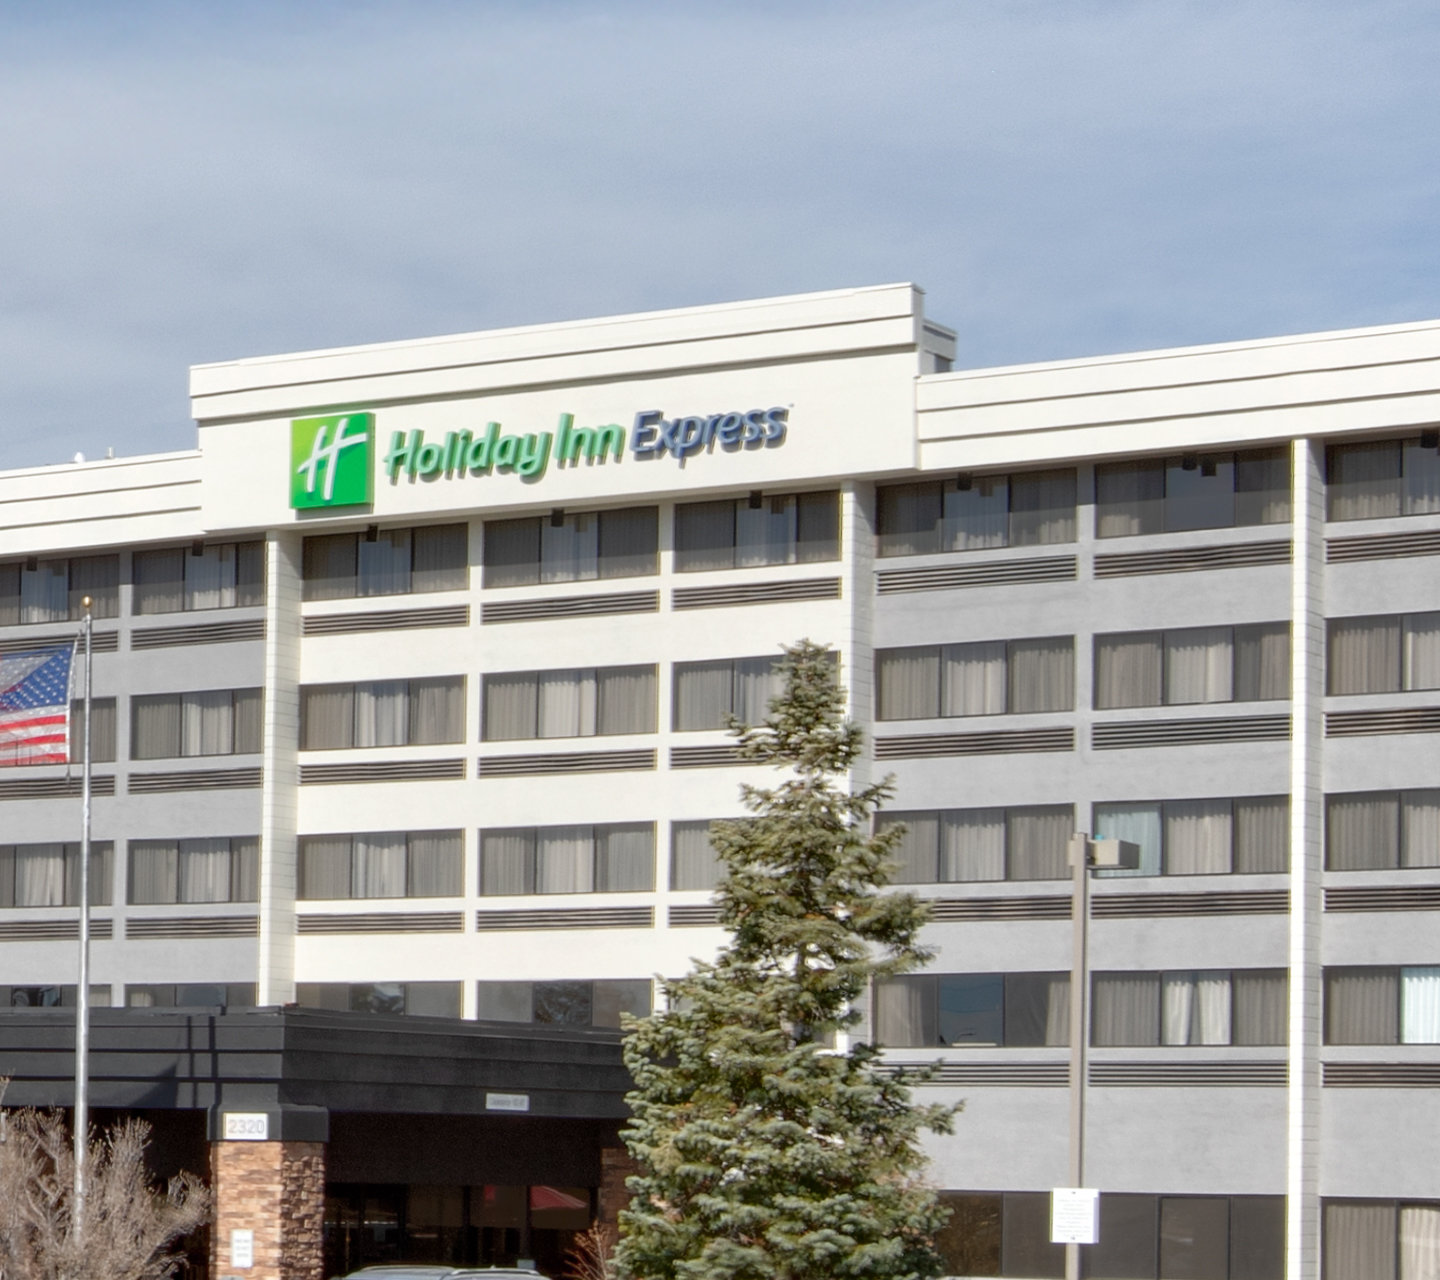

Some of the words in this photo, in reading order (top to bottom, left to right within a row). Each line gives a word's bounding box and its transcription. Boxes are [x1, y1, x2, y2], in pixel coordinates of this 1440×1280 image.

[383, 421, 554, 478] Holiday
[554, 413, 625, 462] Inn
[629, 407, 789, 461] Express
[228, 1119, 265, 1134] 2320
